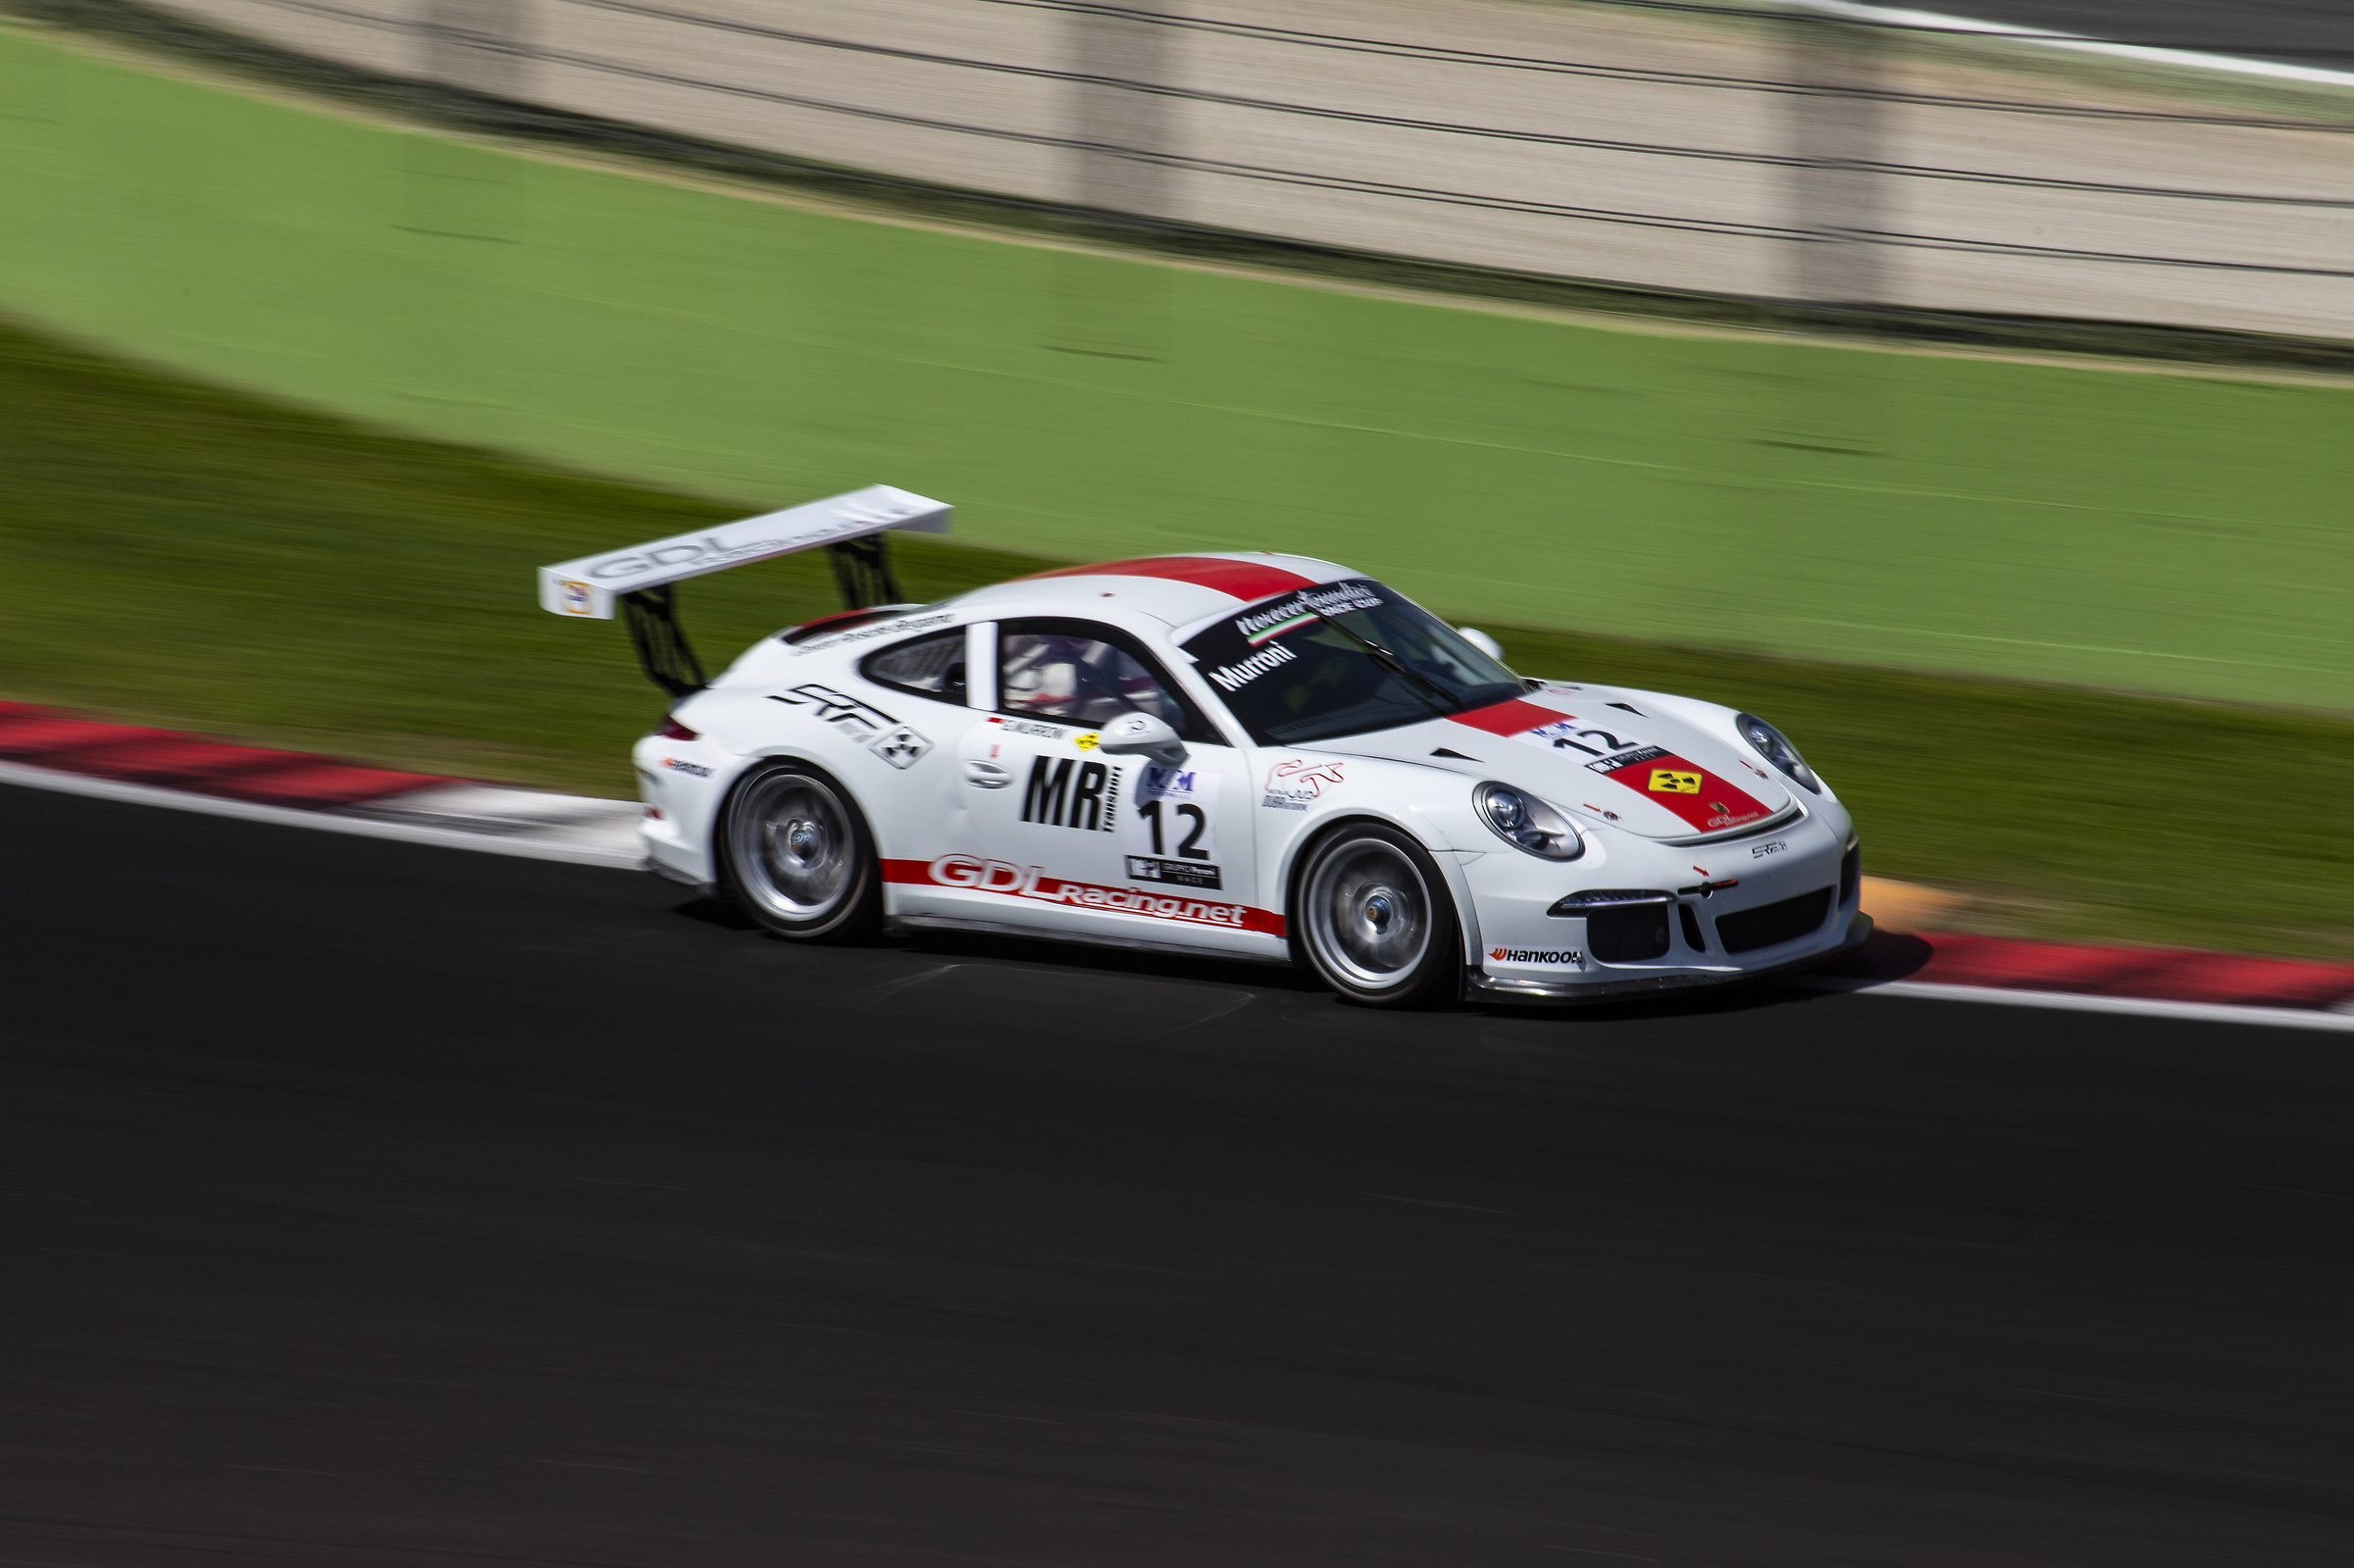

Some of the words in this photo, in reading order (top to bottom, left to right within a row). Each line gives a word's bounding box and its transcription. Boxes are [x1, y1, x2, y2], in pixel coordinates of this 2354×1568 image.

[588, 536, 767, 579] GDL
[1208, 640, 1297, 692] Murroni
[1554, 730, 1641, 757] 12
[1020, 754, 1106, 832] MR
[1138, 800, 1209, 860] 12
[928, 853, 1059, 900] GDL
